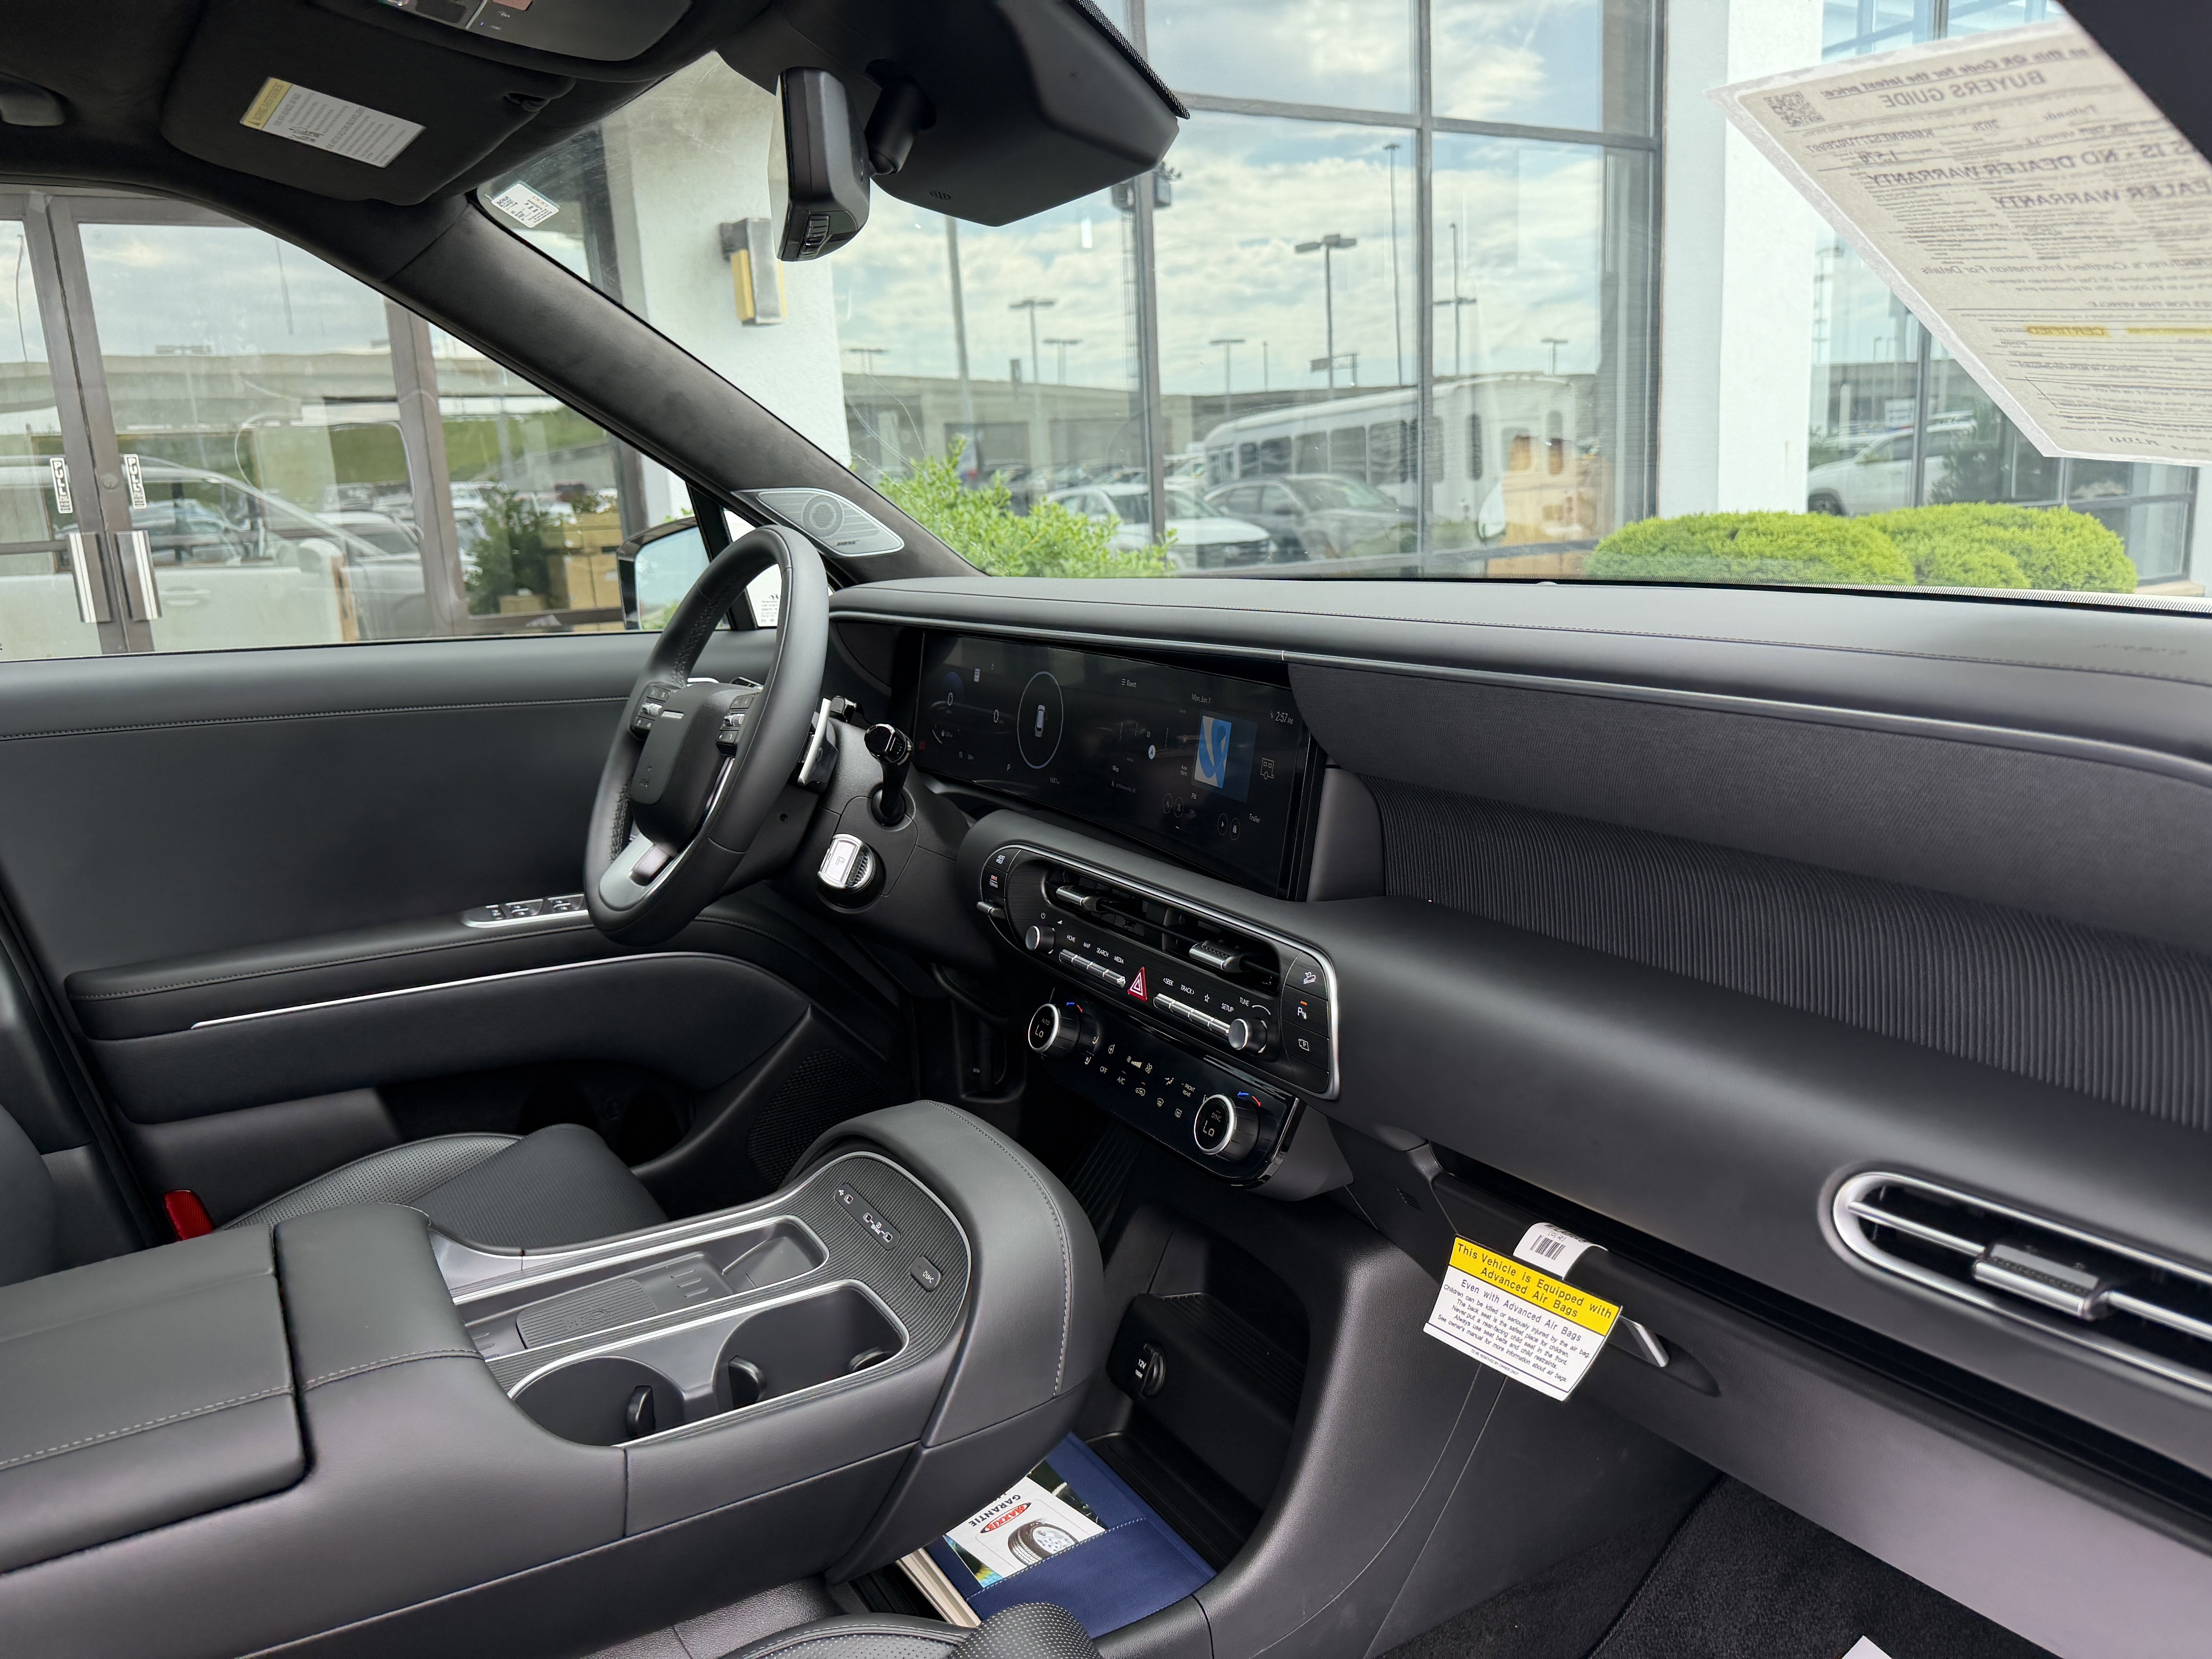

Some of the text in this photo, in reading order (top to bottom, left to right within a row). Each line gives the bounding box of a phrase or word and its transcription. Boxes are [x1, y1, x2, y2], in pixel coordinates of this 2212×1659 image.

[53, 461, 67, 496] PULL
[128, 458, 142, 492] PULL
[1275, 711, 1288, 722] 2:57
[1249, 814, 1261, 823] Trailer
[836, 856, 845, 865] P
[1096, 948, 1109, 957] SEARCH
[1114, 955, 1124, 964] MEDIA
[1221, 1003, 1234, 1013] SETUP
[1239, 997, 1250, 1006] TUNE
[1184, 1084, 1195, 1092] FRONT
[1211, 1112, 1222, 1122] SYNC
[1458, 1243, 1611, 1319] This Vehicle is Equipped with
[1480, 1267, 1578, 1317] Advanced Air Bags
[1444, 1284, 1463, 1298] Children
[1485, 1304, 1499, 1314] killed
[1508, 1316, 1530, 1330] seriously
[1531, 1326, 1549, 1339] injured
[1550, 1335, 1558, 1343] by
[1579, 1349, 1590, 1358] bag.
[1461, 1279, 1582, 1341] Even with Advanced Air Bags
[1452, 1305, 1467, 1316] Never
[1482, 1321, 1509, 1338] rear-facing
[1510, 1334, 1523, 1344] child
[1524, 1342, 1536, 1350] seat
[1554, 1355, 1567, 1365] front.
[1454, 1314, 1471, 1326] Always
[1496, 1335, 1508, 1345] belts
[1521, 1348, 1533, 1357] child
[1534, 1355, 1557, 1369] restraints.
[1457, 1298, 1466, 1307] The
[1467, 1304, 1479, 1314] back
[1480, 1312, 1492, 1320] seat
[1509, 1326, 1524, 1336] safest
[1525, 1333, 1539, 1343] place
[1549, 1345, 1569, 1357] children.
[1138, 1359, 1147, 1369] 12V
[1437, 1314, 1447, 1322] See
[1448, 1321, 1465, 1332] owner's
[1466, 1330, 1484, 1341] manual
[1492, 1343, 1504, 1352] more
[1506, 1348, 1531, 1365] information
[1532, 1363, 1547, 1372] about
[1555, 1373, 1567, 1382] bags.
[968, 1494, 1021, 1527] GARANTIE
